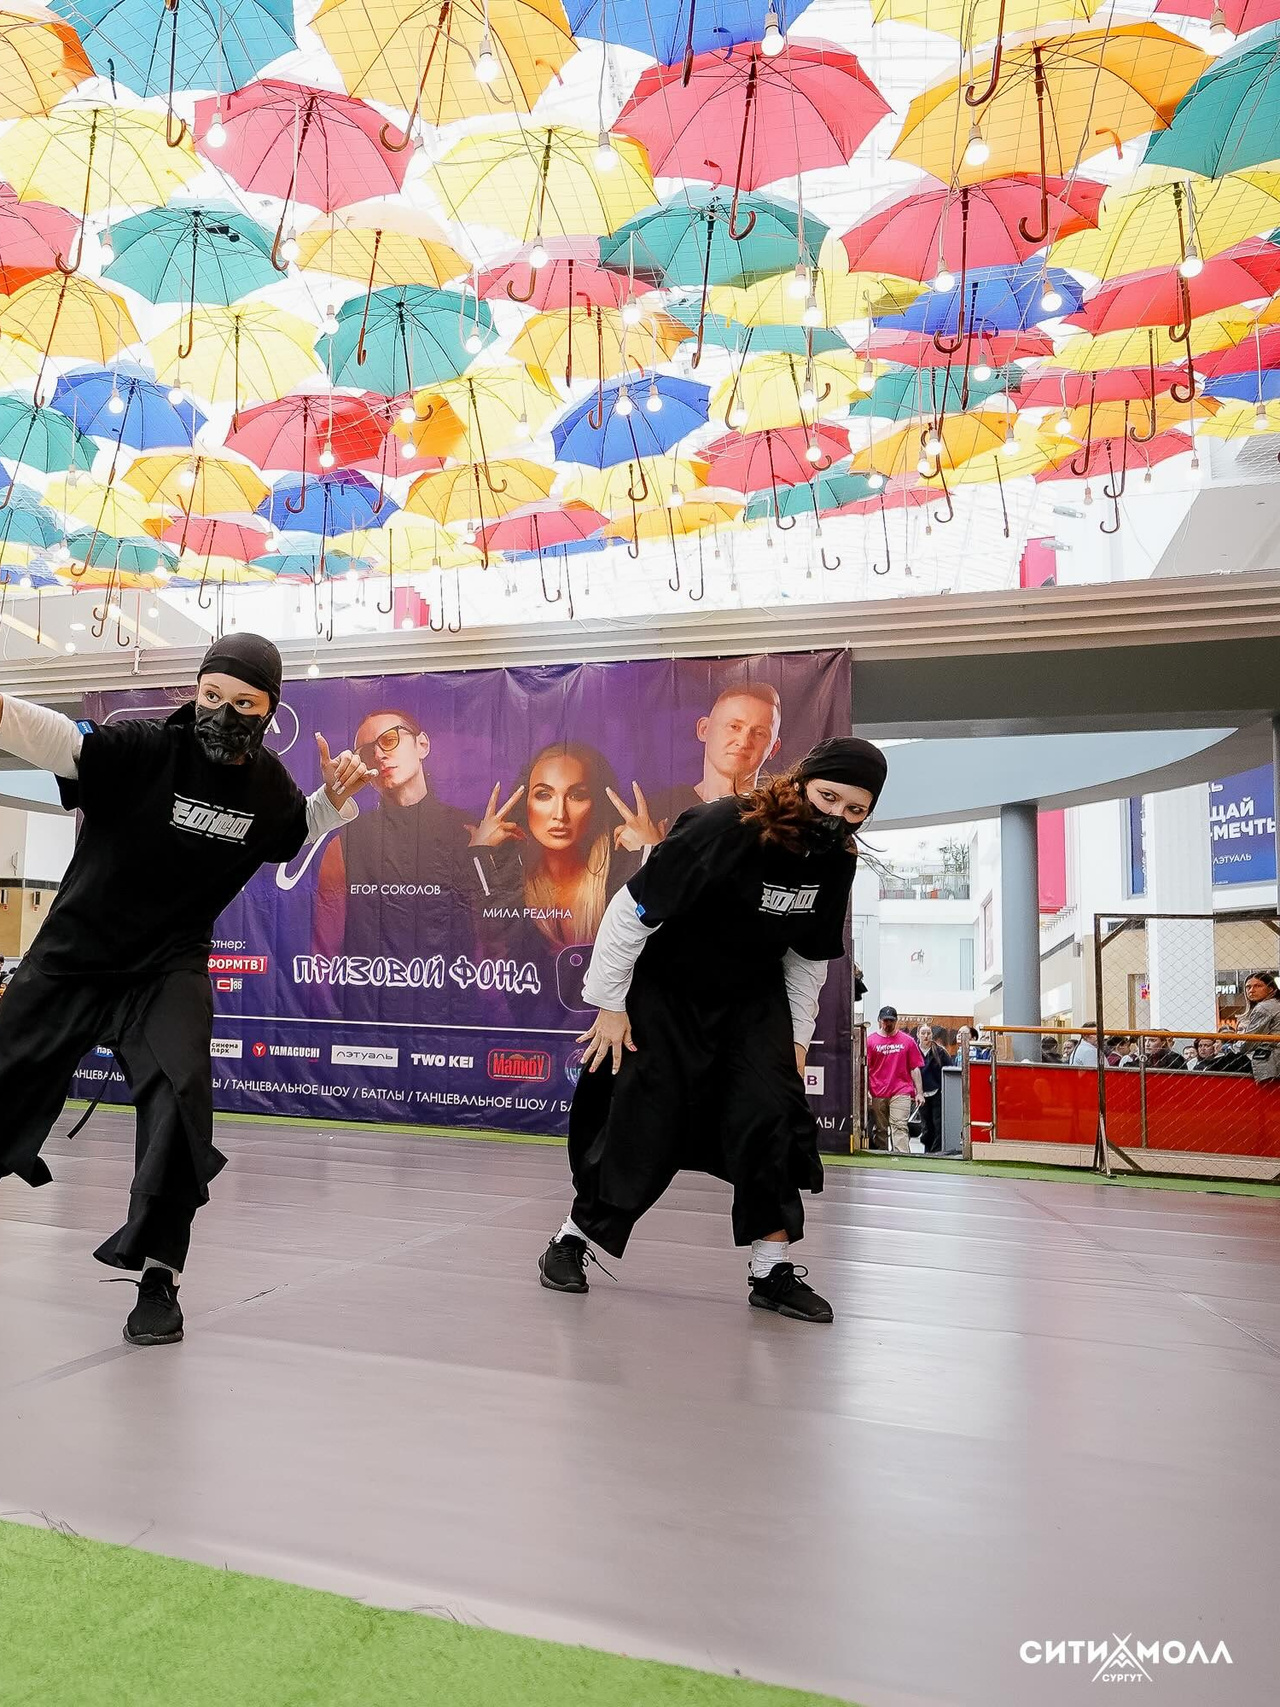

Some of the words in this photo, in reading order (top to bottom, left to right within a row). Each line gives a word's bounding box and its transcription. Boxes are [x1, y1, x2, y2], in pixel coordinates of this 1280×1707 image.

[350, 885, 379, 895] ЕГОР
[381, 885, 441, 895] СОКОЛОВ
[483, 908, 520, 919] МИЛА
[523, 908, 572, 920] РЕДИНА
[293, 955, 445, 988] ПРИЗОВОЙ
[449, 955, 541, 995] ФОНД
[269, 1046, 320, 1058] YAMAGUCHI
[411, 1053, 446, 1067] TWO
[449, 1055, 474, 1068] KEI
[231, 1079, 318, 1095] ТАНЦЕВАЛЬНОЕ
[321, 1086, 350, 1098] ШОУ
[361, 1088, 404, 1101] БАТТЛЫ
[415, 1091, 512, 1108] ТАНЦЕВАЛЬНОЕ
[515, 1098, 547, 1111] ШОУ
